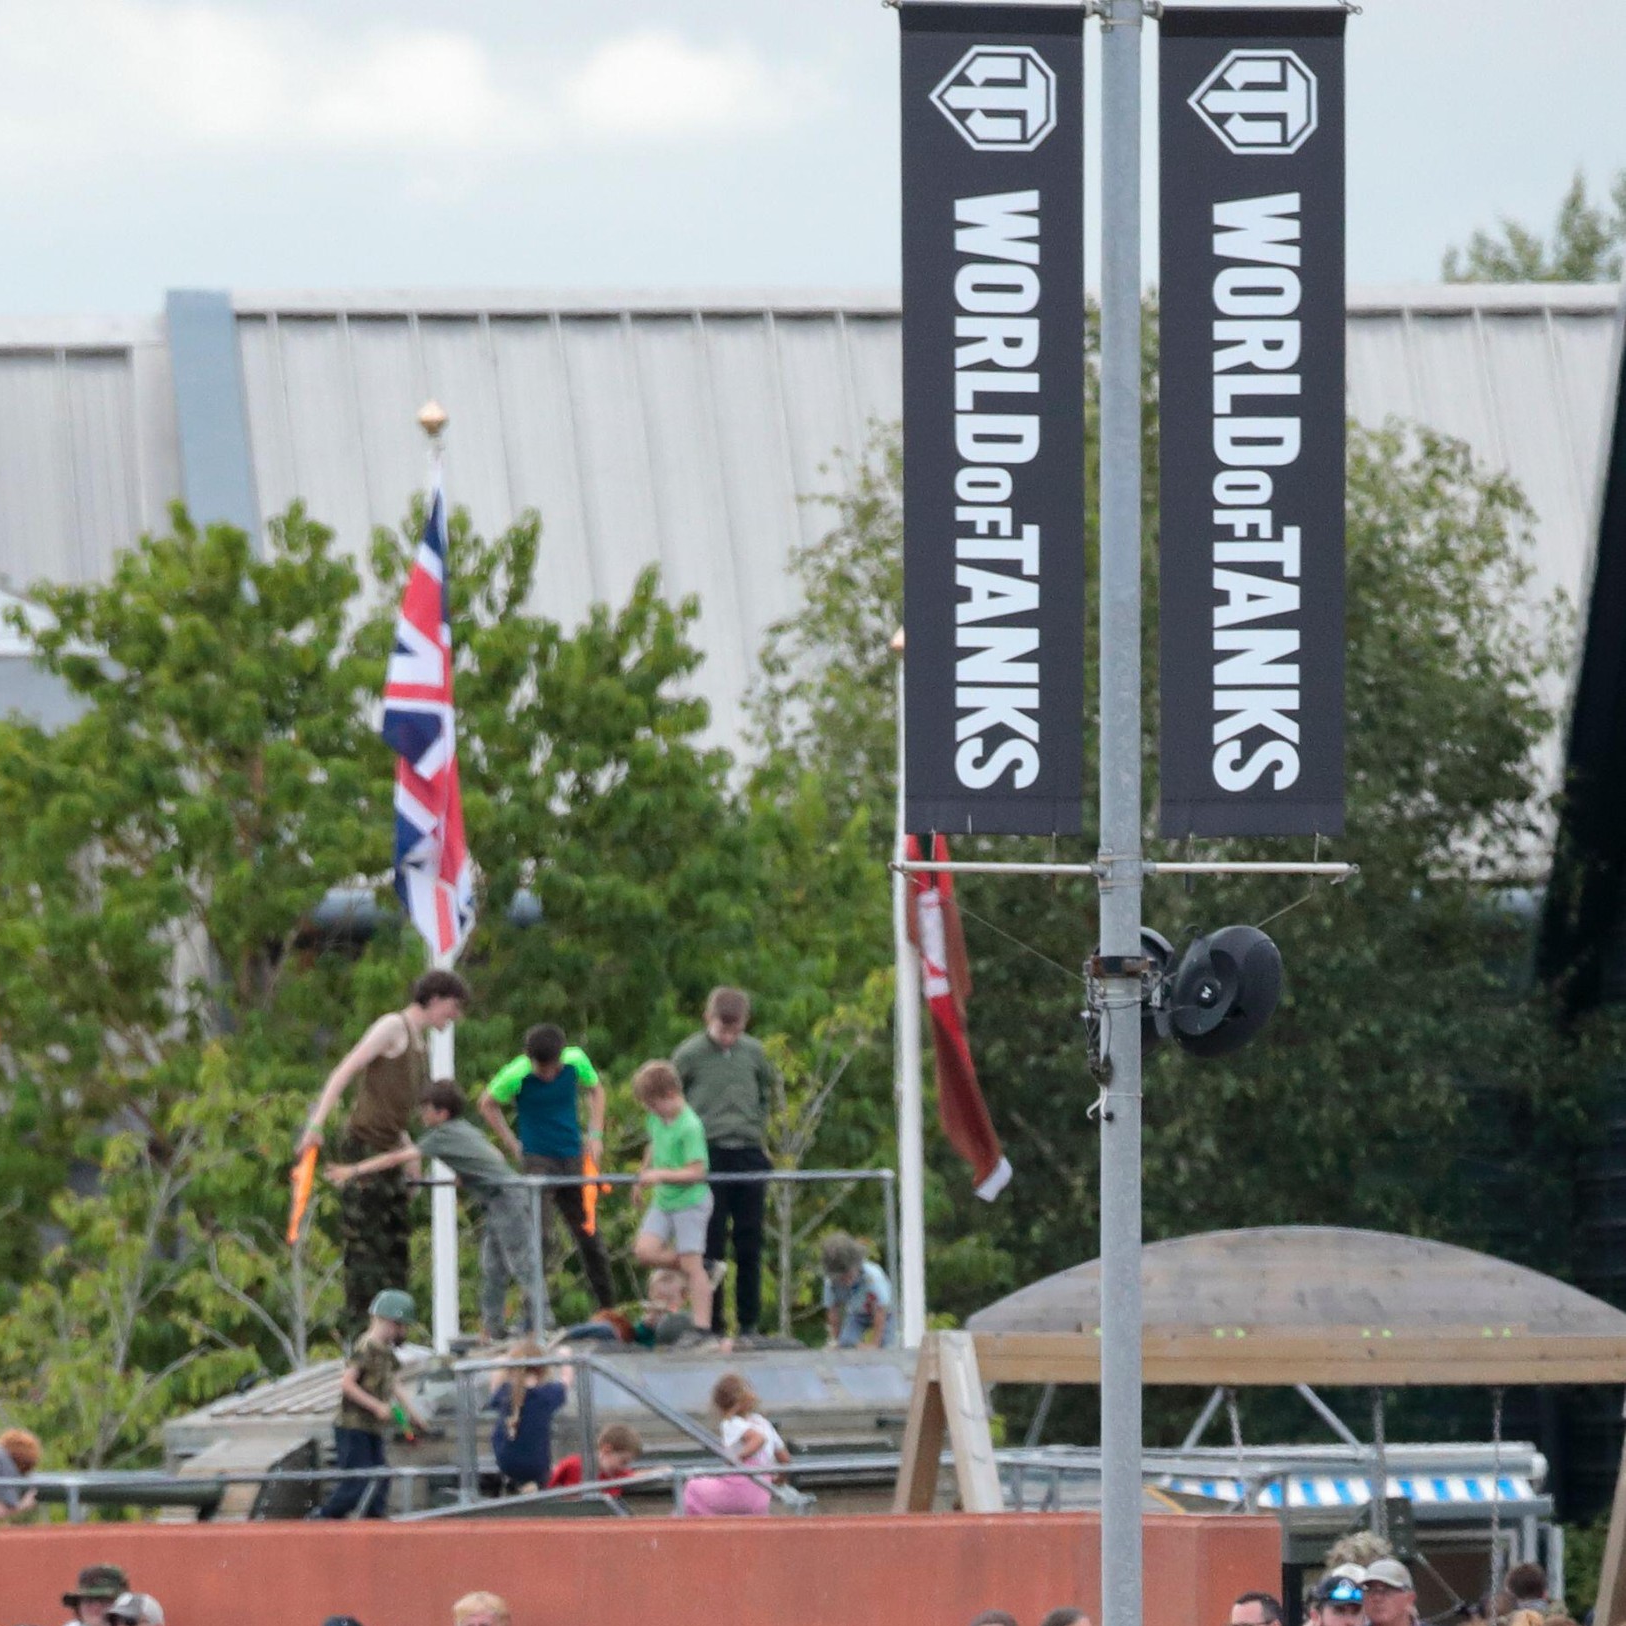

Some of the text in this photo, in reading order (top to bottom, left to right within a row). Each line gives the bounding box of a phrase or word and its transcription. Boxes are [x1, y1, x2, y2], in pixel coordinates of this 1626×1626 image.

[954, 189, 1041, 464] WORLD
[1212, 192, 1302, 467] WORLD
[955, 524, 1041, 790] TANKS
[1212, 526, 1301, 792] TANKS
